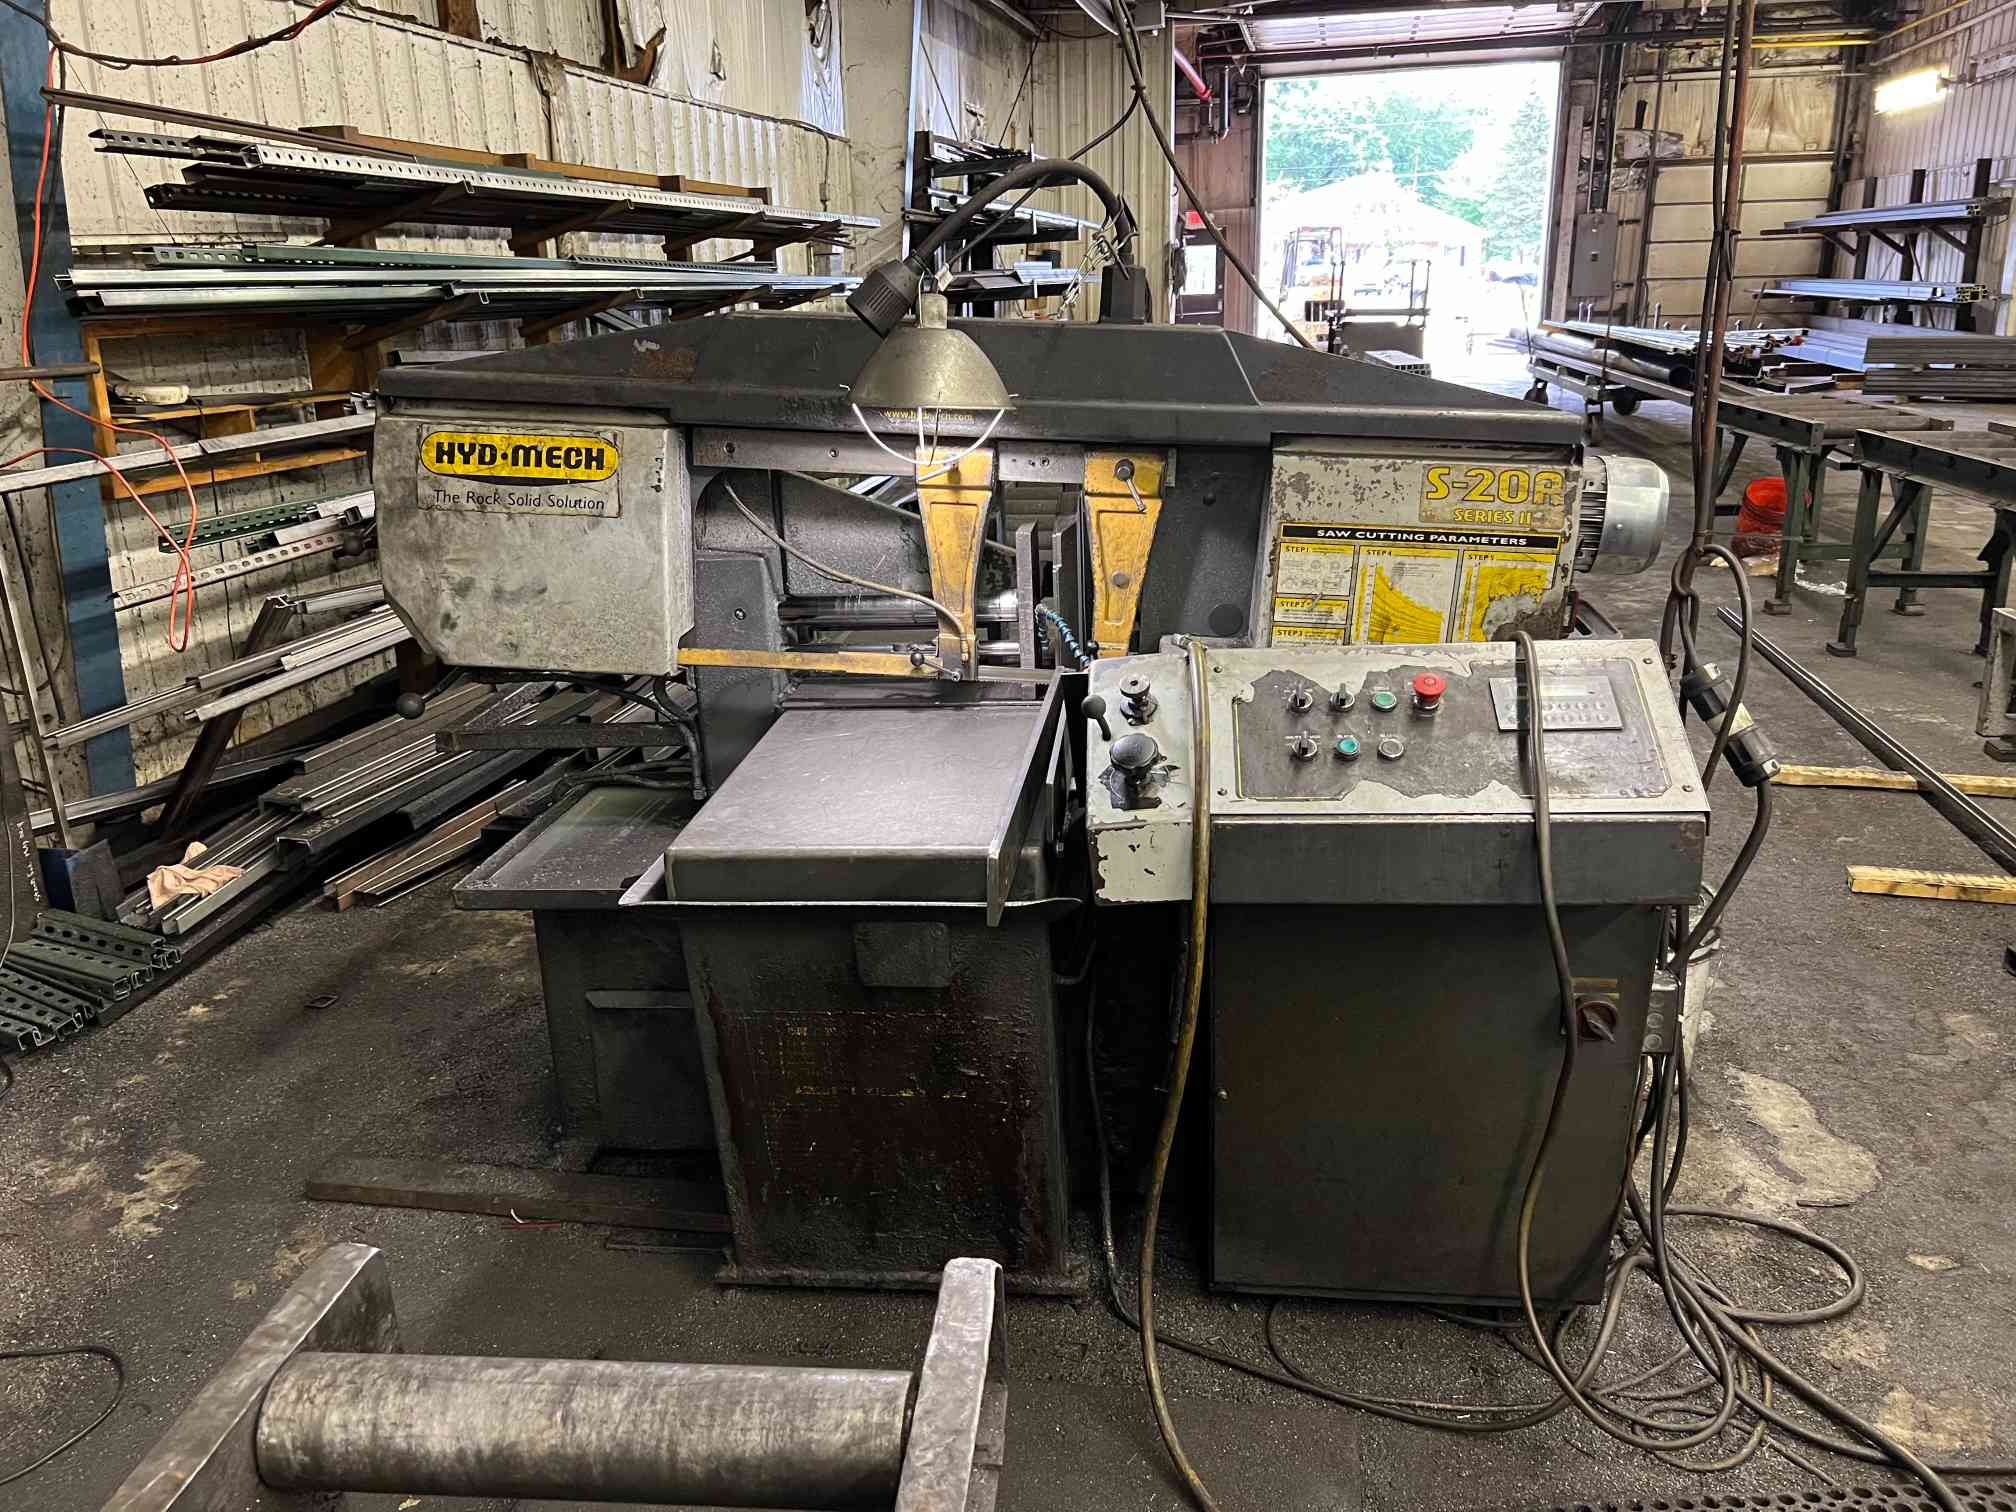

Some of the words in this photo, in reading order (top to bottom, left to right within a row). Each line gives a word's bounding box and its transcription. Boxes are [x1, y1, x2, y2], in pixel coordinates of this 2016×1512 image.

[434, 490, 460, 504] The
[466, 490, 501, 506] Rock
[508, 493, 542, 507] Solid
[549, 495, 605, 510] Solution
[1454, 508, 1514, 524] SERIES
[1316, 529, 1351, 538] SAW
[1355, 531, 1424, 541] CUTTING
[1429, 534, 1527, 546] PARAMETERS
